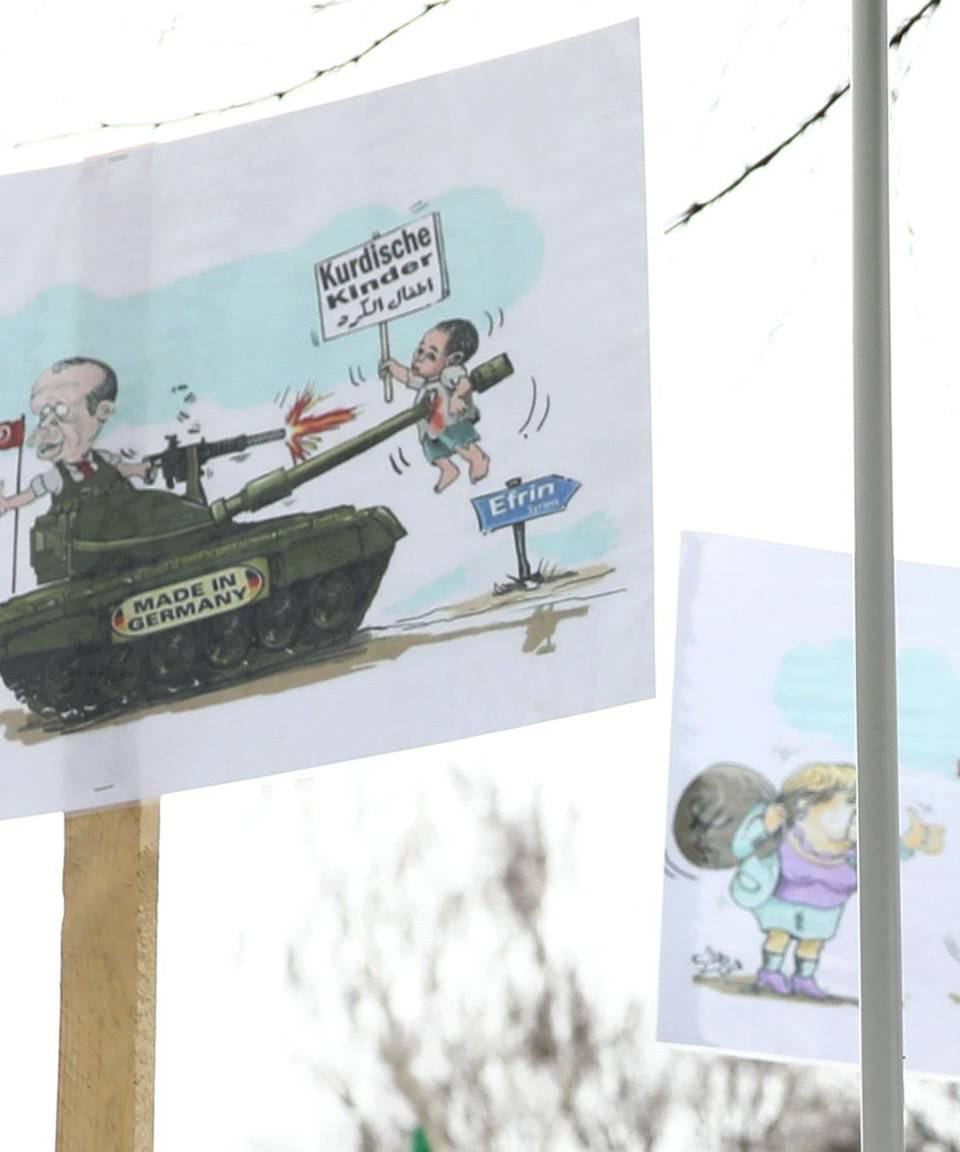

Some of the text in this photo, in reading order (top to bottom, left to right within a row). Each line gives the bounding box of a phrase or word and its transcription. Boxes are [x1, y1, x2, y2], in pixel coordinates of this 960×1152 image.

[319, 226, 432, 291] Kurdische
[488, 481, 555, 518] Efrin
[128, 586, 247, 631] GERMANY
[134, 574, 236, 613] MADE IN
